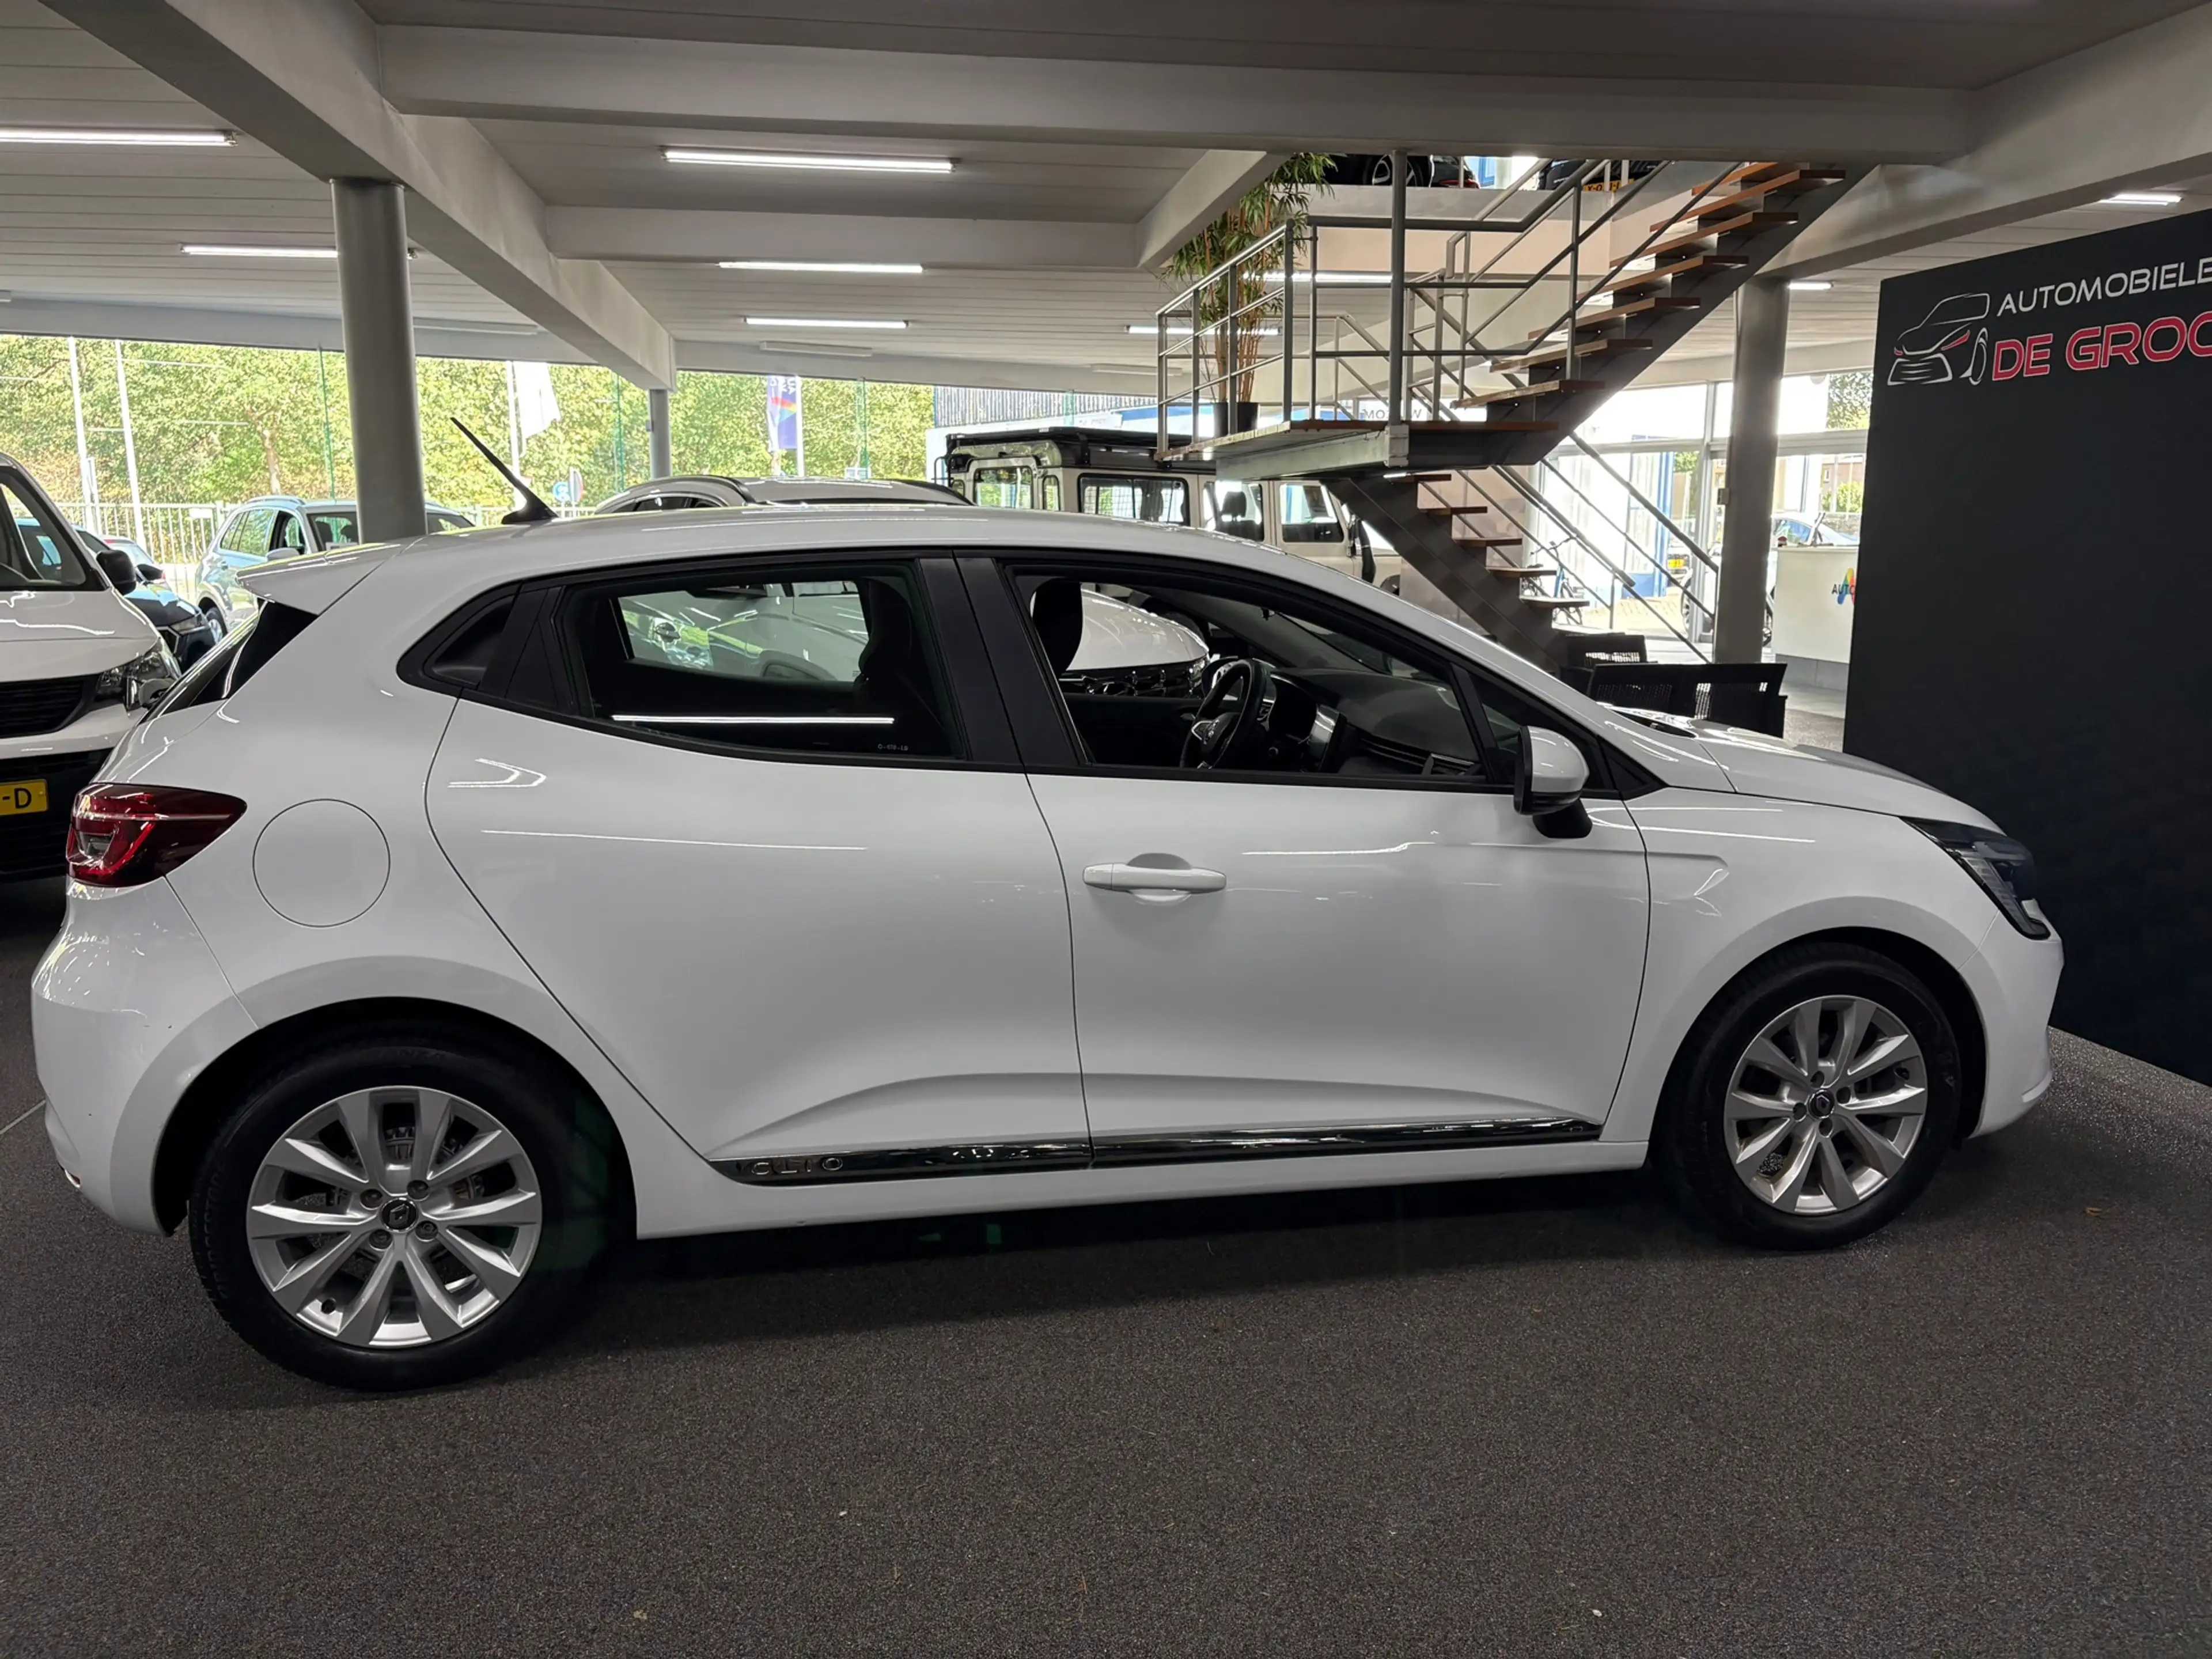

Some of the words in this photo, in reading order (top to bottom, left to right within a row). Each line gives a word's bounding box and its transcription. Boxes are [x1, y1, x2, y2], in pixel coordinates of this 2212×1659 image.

[1997, 257, 2212, 316] AUTOMOBIELE
[1993, 334, 2053, 381] DE
[751, 1157, 843, 1175] CLIO
